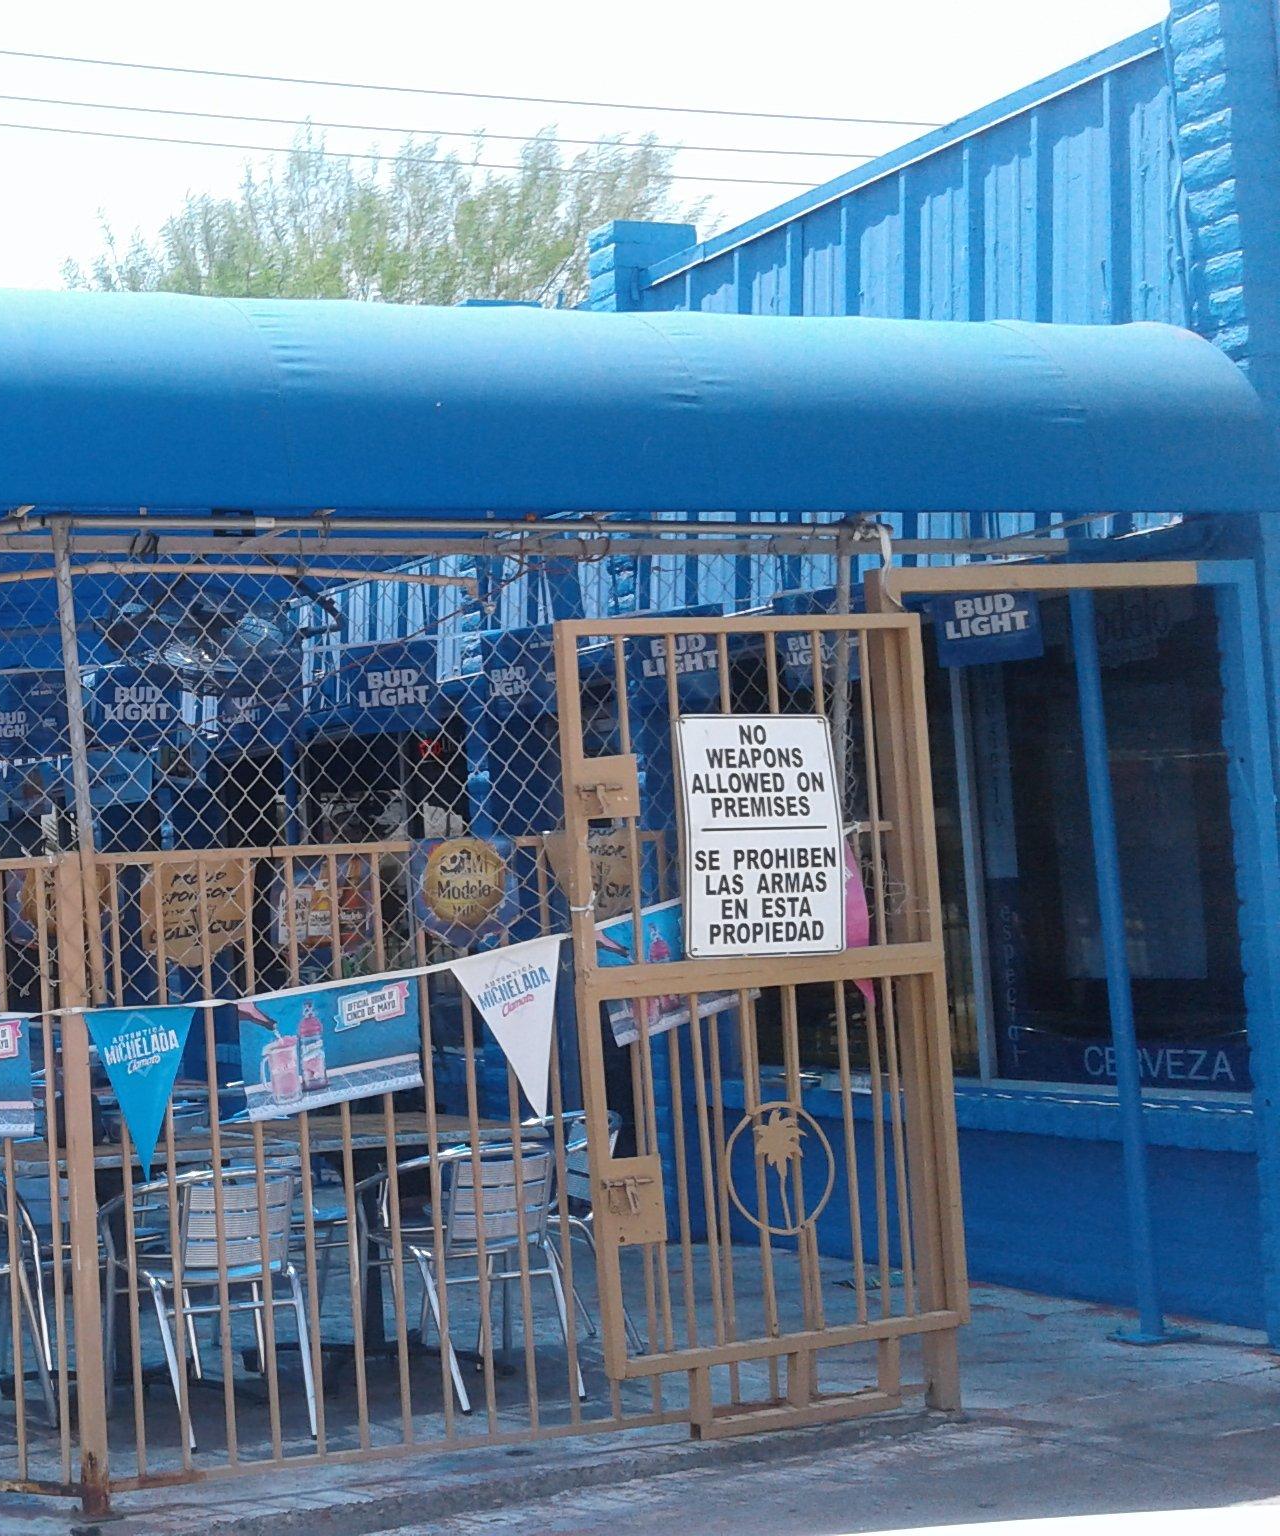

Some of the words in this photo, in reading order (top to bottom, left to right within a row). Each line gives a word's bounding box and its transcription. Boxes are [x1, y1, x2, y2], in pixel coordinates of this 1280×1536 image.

[954, 593, 1015, 619] BUD
[945, 610, 1029, 640] LIGHT
[367, 668, 420, 690] BUD
[114, 686, 161, 703] BUD
[358, 685, 429, 708] LIGHT
[104, 702, 169, 720] LIGHT
[738, 725, 767, 745] NO
[706, 748, 804, 769] WEAPONS
[691, 772, 785, 794] ALLOWED
[797, 772, 825, 793] ON
[711, 796, 811, 818] PREMISES
[694, 850, 720, 871] SE
[733, 847, 837, 870] PROHIBEN
[437, 880, 491, 900] Modelo
[705, 874, 744, 896] LAS
[757, 871, 827, 894] ARMAS
[721, 898, 748, 920] EN
[761, 896, 812, 918] ESTA
[709, 921, 824, 944] PROPIEDAD
[477, 966, 551, 1011] MICHELADA
[346, 1009, 366, 1021] CINCO
[377, 999, 397, 1012] MAYO
[347, 1000, 369, 1012] OFFICIAL
[502, 993, 535, 1018] Clamato
[104, 1029, 179, 1066] MICHELADA
[128, 1055, 161, 1074] Clamato
[1084, 1045, 1235, 1081] CEVEZA
